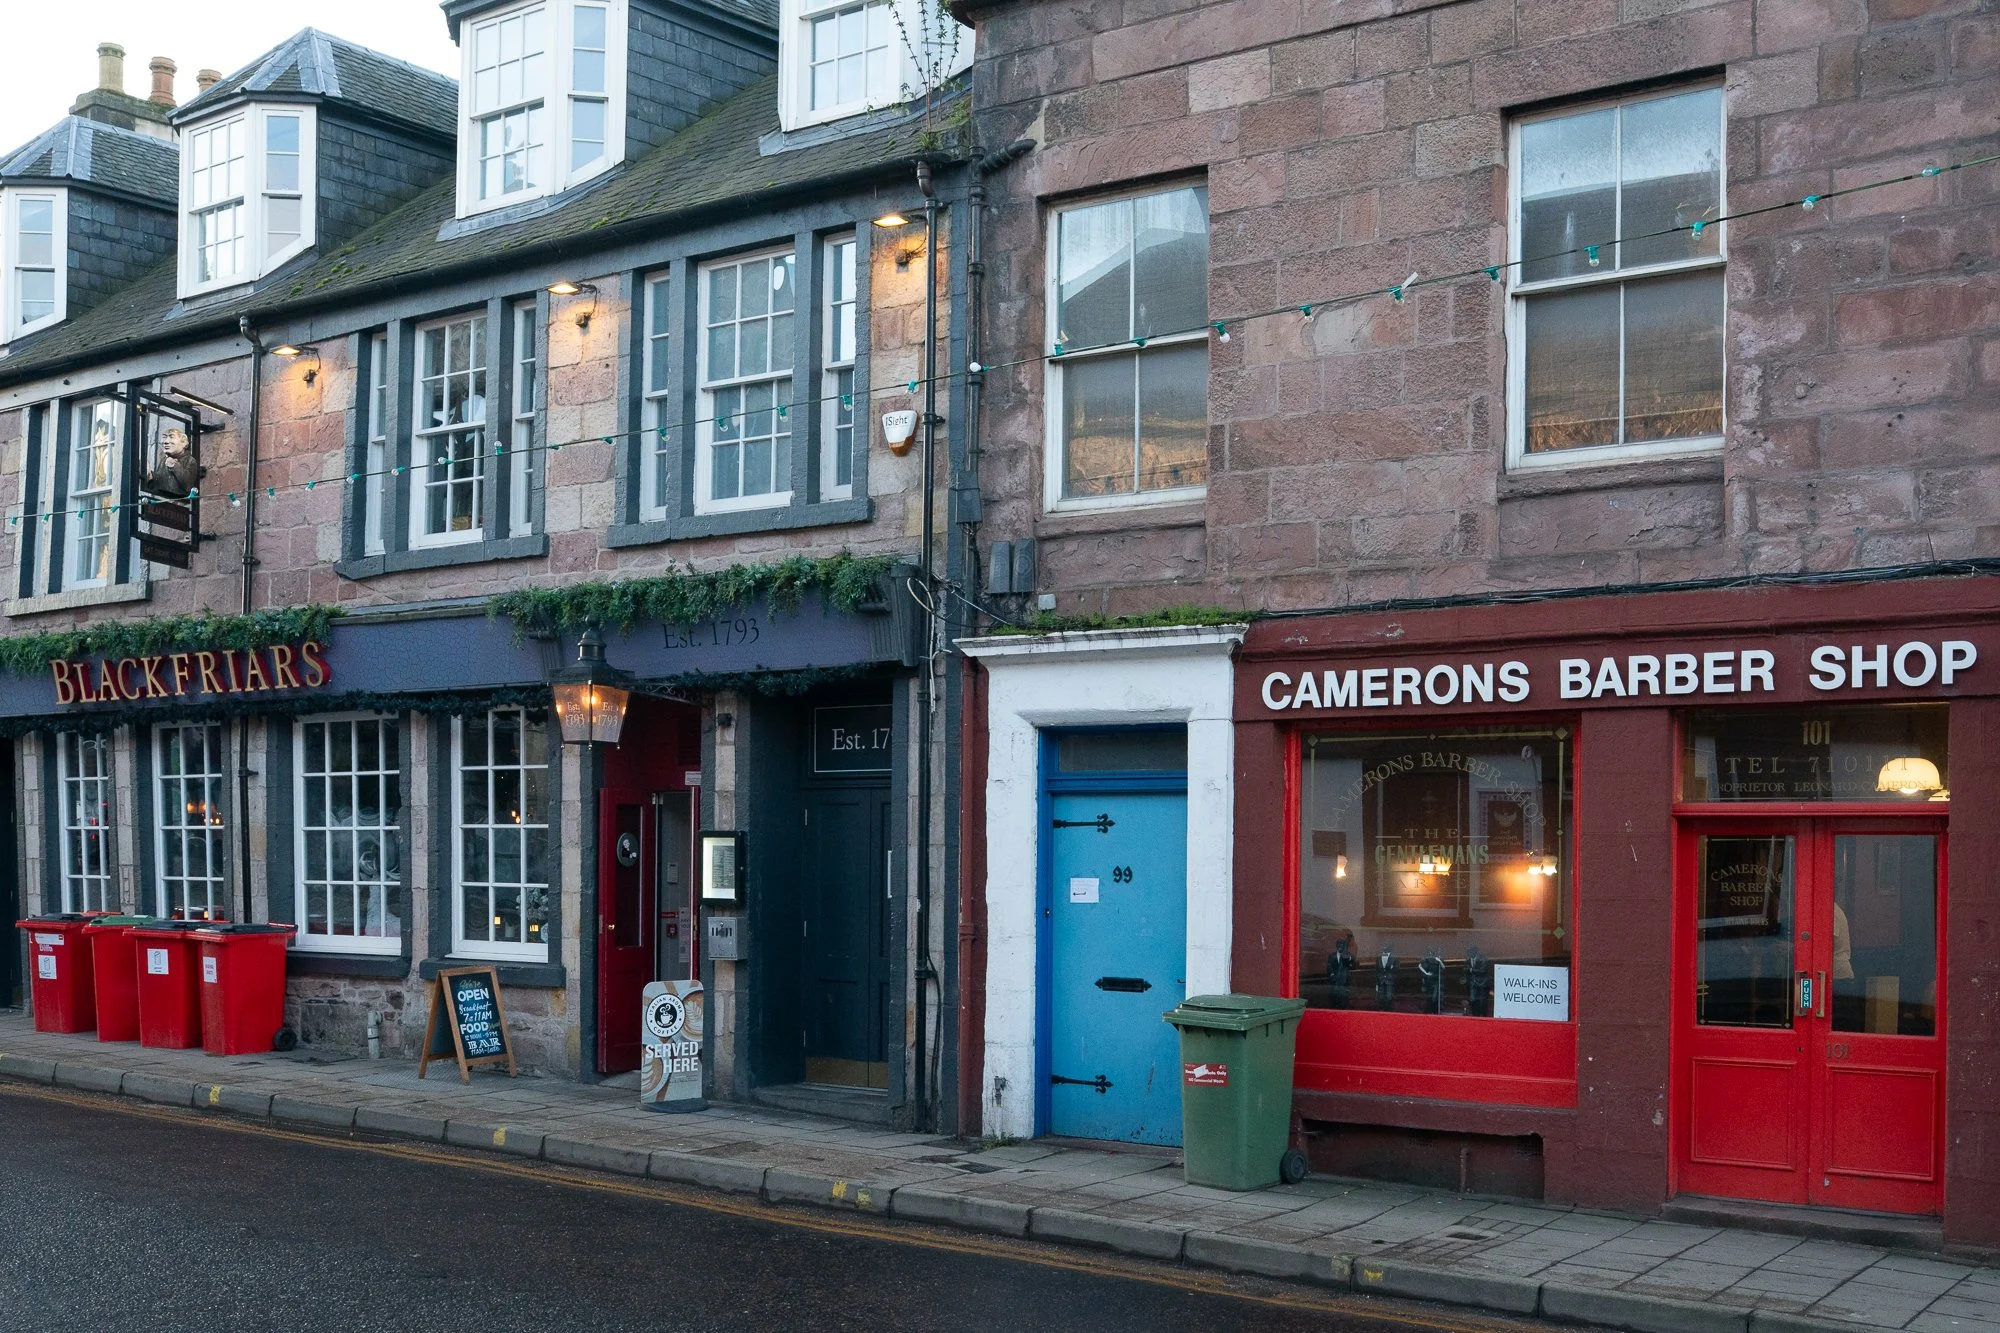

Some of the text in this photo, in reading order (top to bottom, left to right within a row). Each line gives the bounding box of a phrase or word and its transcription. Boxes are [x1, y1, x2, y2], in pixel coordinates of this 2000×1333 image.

[662, 617, 760, 649] Est. 1793
[50, 641, 331, 704] BLACKFRIARS
[1261, 640, 1978, 711] CAMERONS BARBER SHOP
[831, 727, 892, 751] Est. 17
[1802, 720, 1831, 746] 101
[1725, 756, 1786, 774] TEL
[1322, 751, 1547, 830] CAMERONS BARBER SHOP
[1711, 780, 1786, 793] ROPRIETOR
[1403, 828, 1460, 839] THE
[1375, 844, 1489, 865] GENTLEMANS
[1113, 865, 1133, 884] 99
[1711, 863, 1783, 882] CAMERONS
[1720, 882, 1773, 893] BARBER
[1730, 896, 1763, 906] SHOP
[1503, 977, 1558, 990] WALK-INS
[457, 988, 490, 1002] OPEN
[1503, 992, 1561, 1005] WELCOME
[649, 997, 683, 1016] ITALIAN AROMA
[460, 1021, 489, 1034] FOOD
[653, 1026, 678, 1036] COFFEE
[468, 1037, 501, 1049] BAR
[645, 1041, 699, 1059] SERVED
[1826, 1042, 1849, 1058] 101
[663, 1057, 699, 1074] HERE
